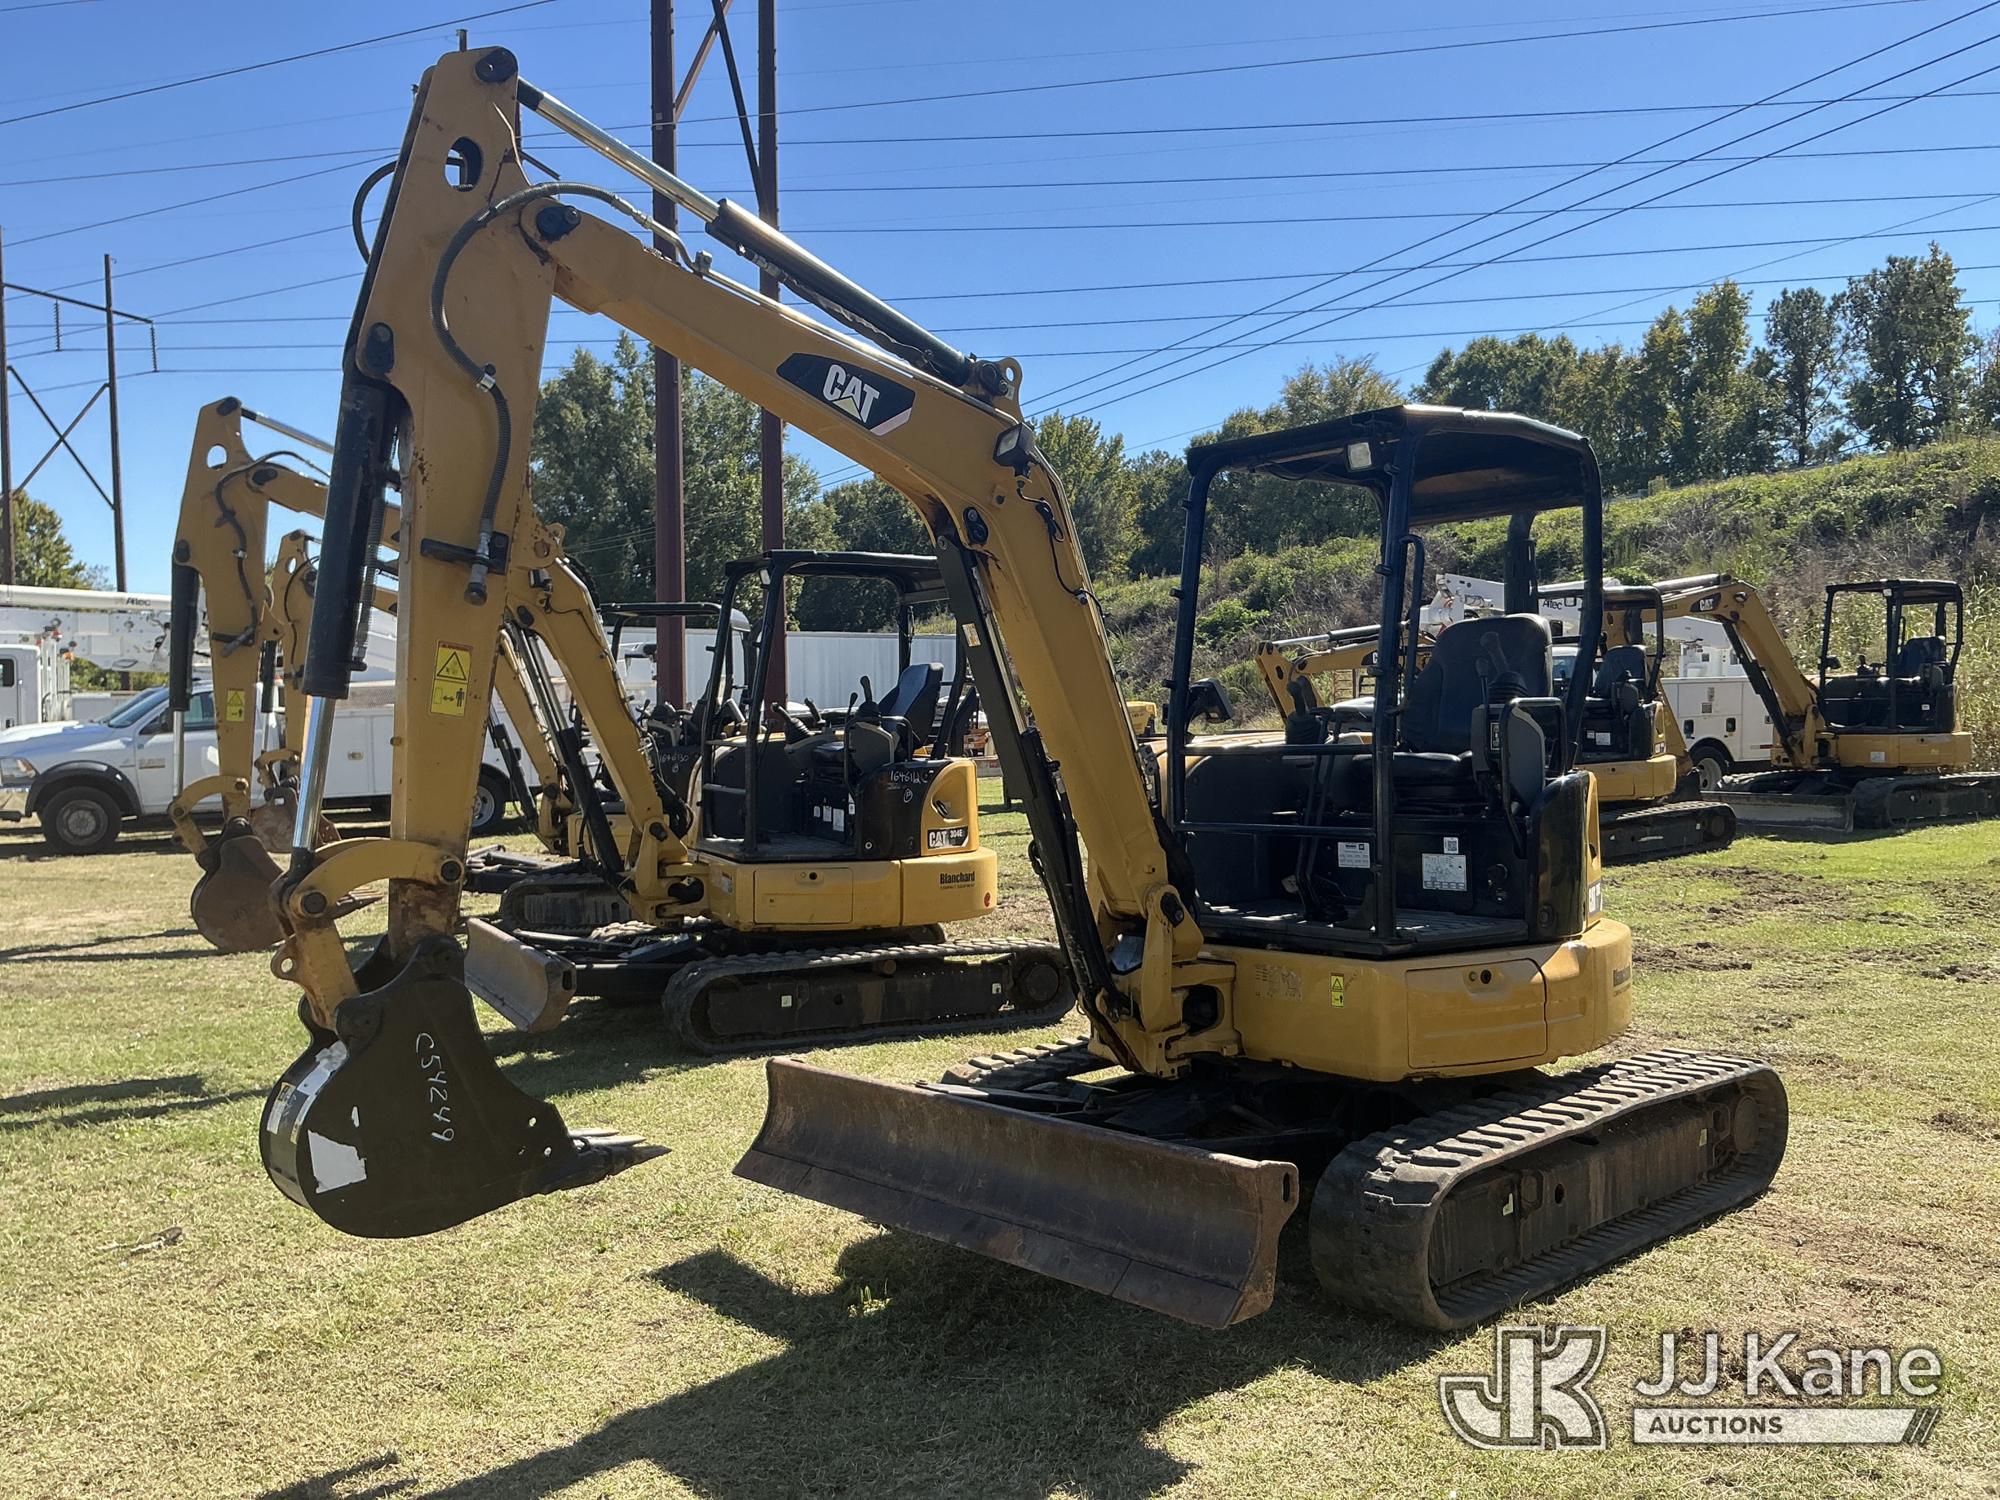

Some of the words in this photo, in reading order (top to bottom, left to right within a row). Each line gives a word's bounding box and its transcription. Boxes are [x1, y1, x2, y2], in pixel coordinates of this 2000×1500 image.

[823, 364, 880, 423] CAT
[1700, 598, 1714, 611] CAT
[929, 831, 947, 848] CAT
[949, 829, 963, 838] 304E
[940, 871, 975, 884] Blanchard
[416, 1032, 455, 1142] C54249
